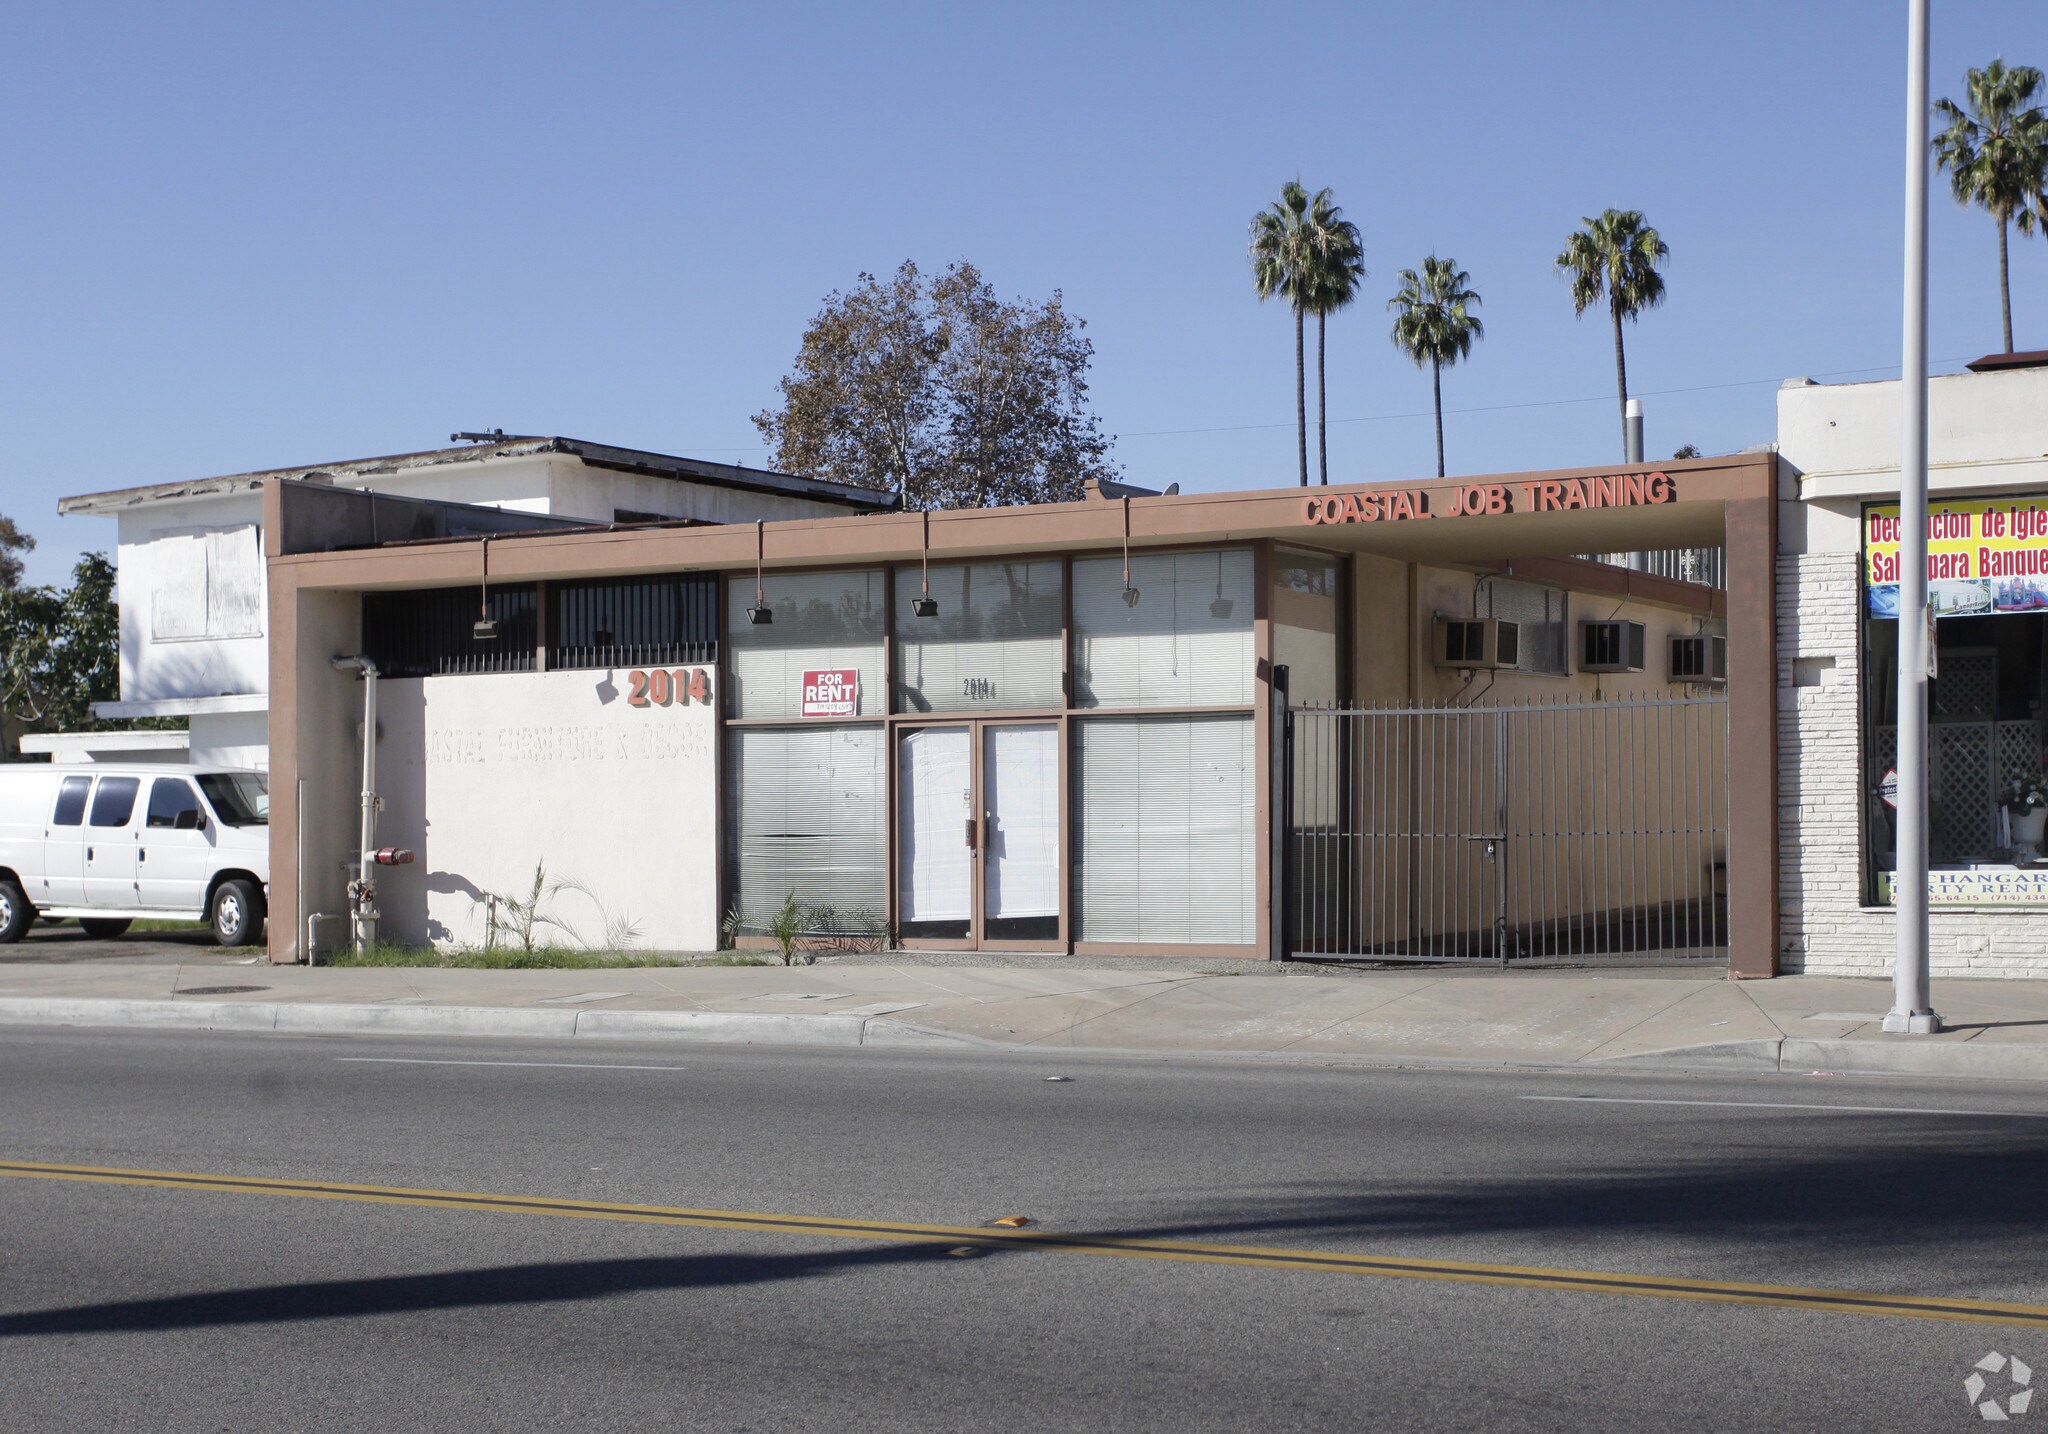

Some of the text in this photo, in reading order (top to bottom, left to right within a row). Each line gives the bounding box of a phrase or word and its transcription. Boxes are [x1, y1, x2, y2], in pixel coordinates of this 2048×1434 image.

[1304, 471, 1670, 526] COASTAL JOB TRAINING
[1870, 509, 1971, 543] Deccion
[1981, 507, 2005, 538] de
[1928, 553, 1970, 581] para
[627, 668, 709, 706] 2014
[805, 684, 854, 702] RENT
[817, 673, 843, 685] FOR
[1982, 884, 2046, 893] RENT
